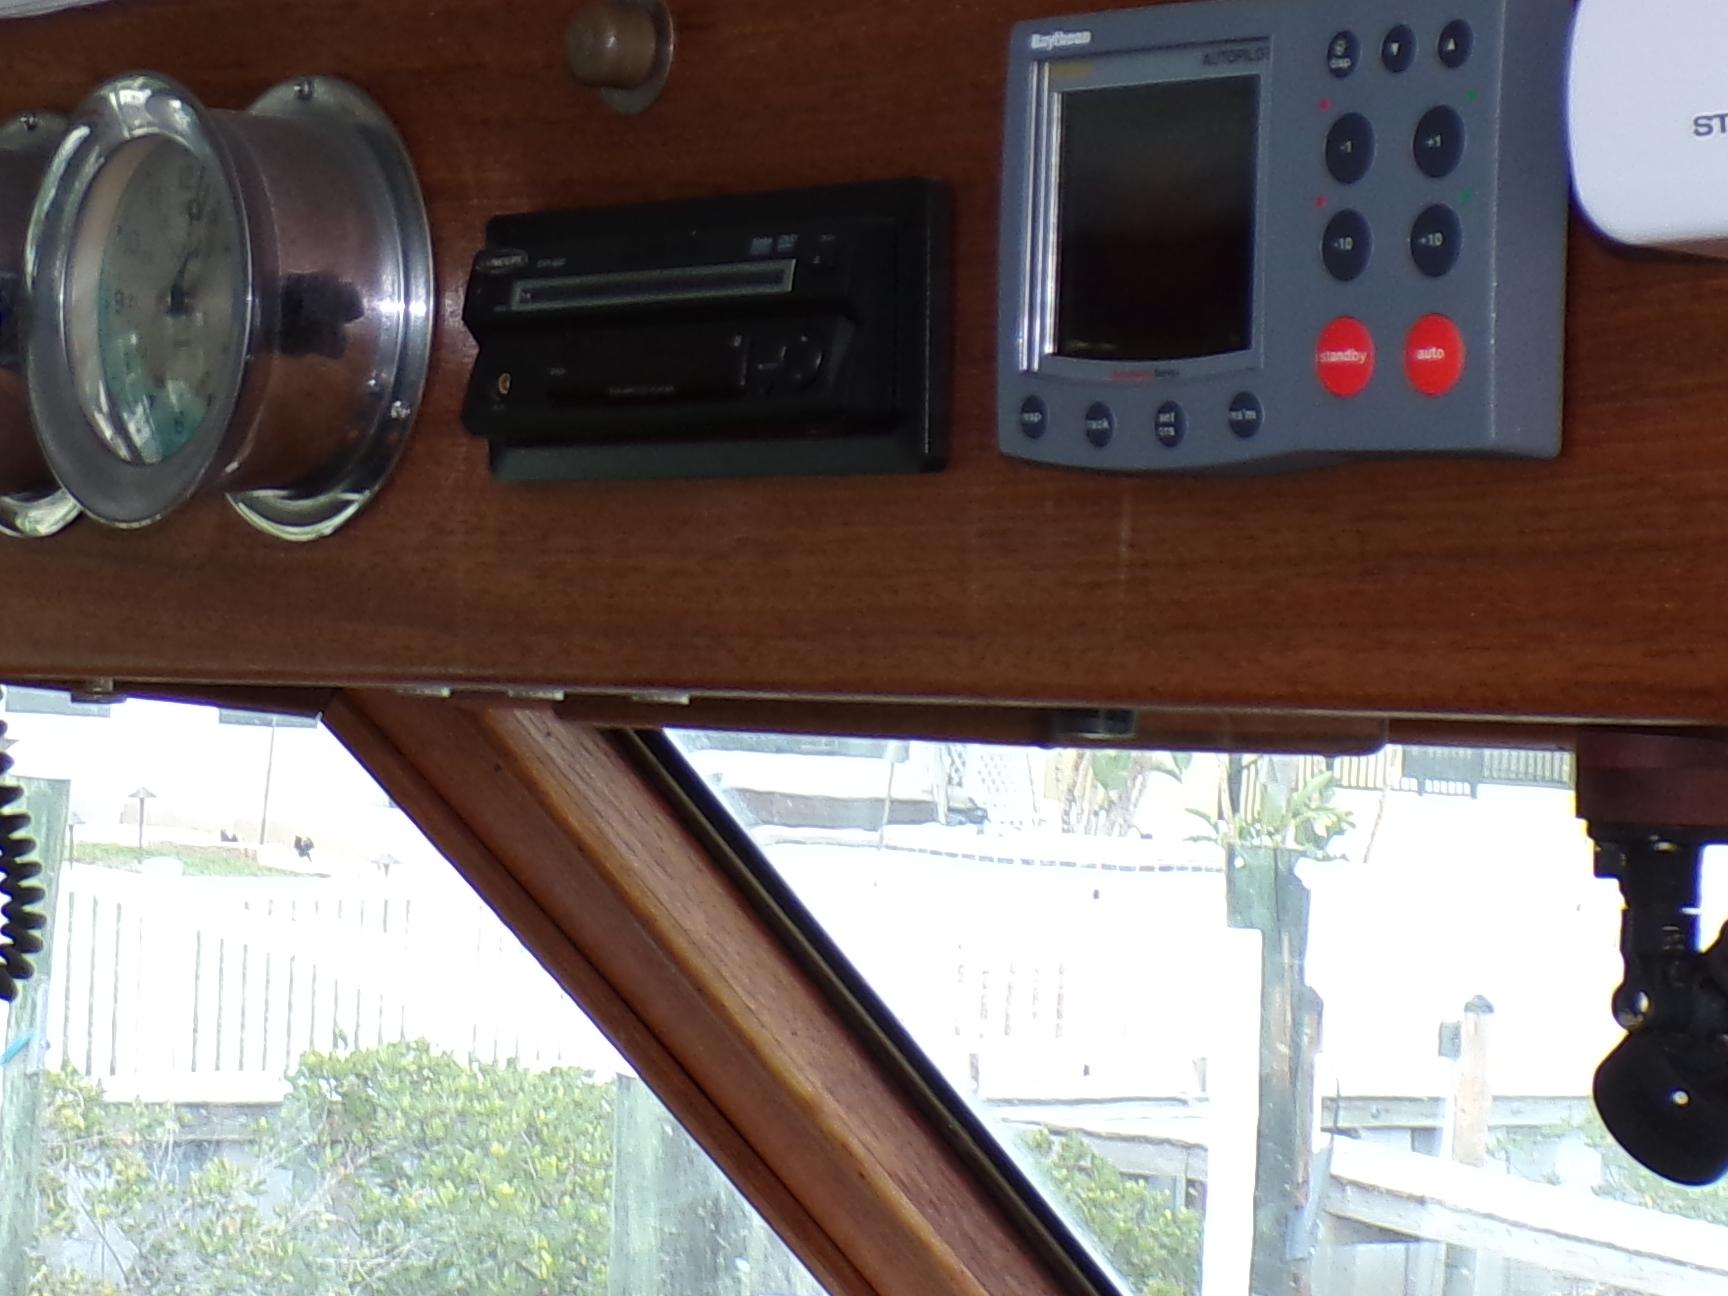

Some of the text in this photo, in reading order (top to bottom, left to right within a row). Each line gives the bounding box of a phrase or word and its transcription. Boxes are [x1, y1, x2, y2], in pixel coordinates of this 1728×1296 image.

[1340, 140, 1352, 153] -1
[1425, 134, 1442, 148] +1
[1334, 236, 1354, 251] -10
[1419, 232, 1444, 247] +10
[1320, 348, 1368, 364] standby
[1416, 347, 1445, 361] auto
